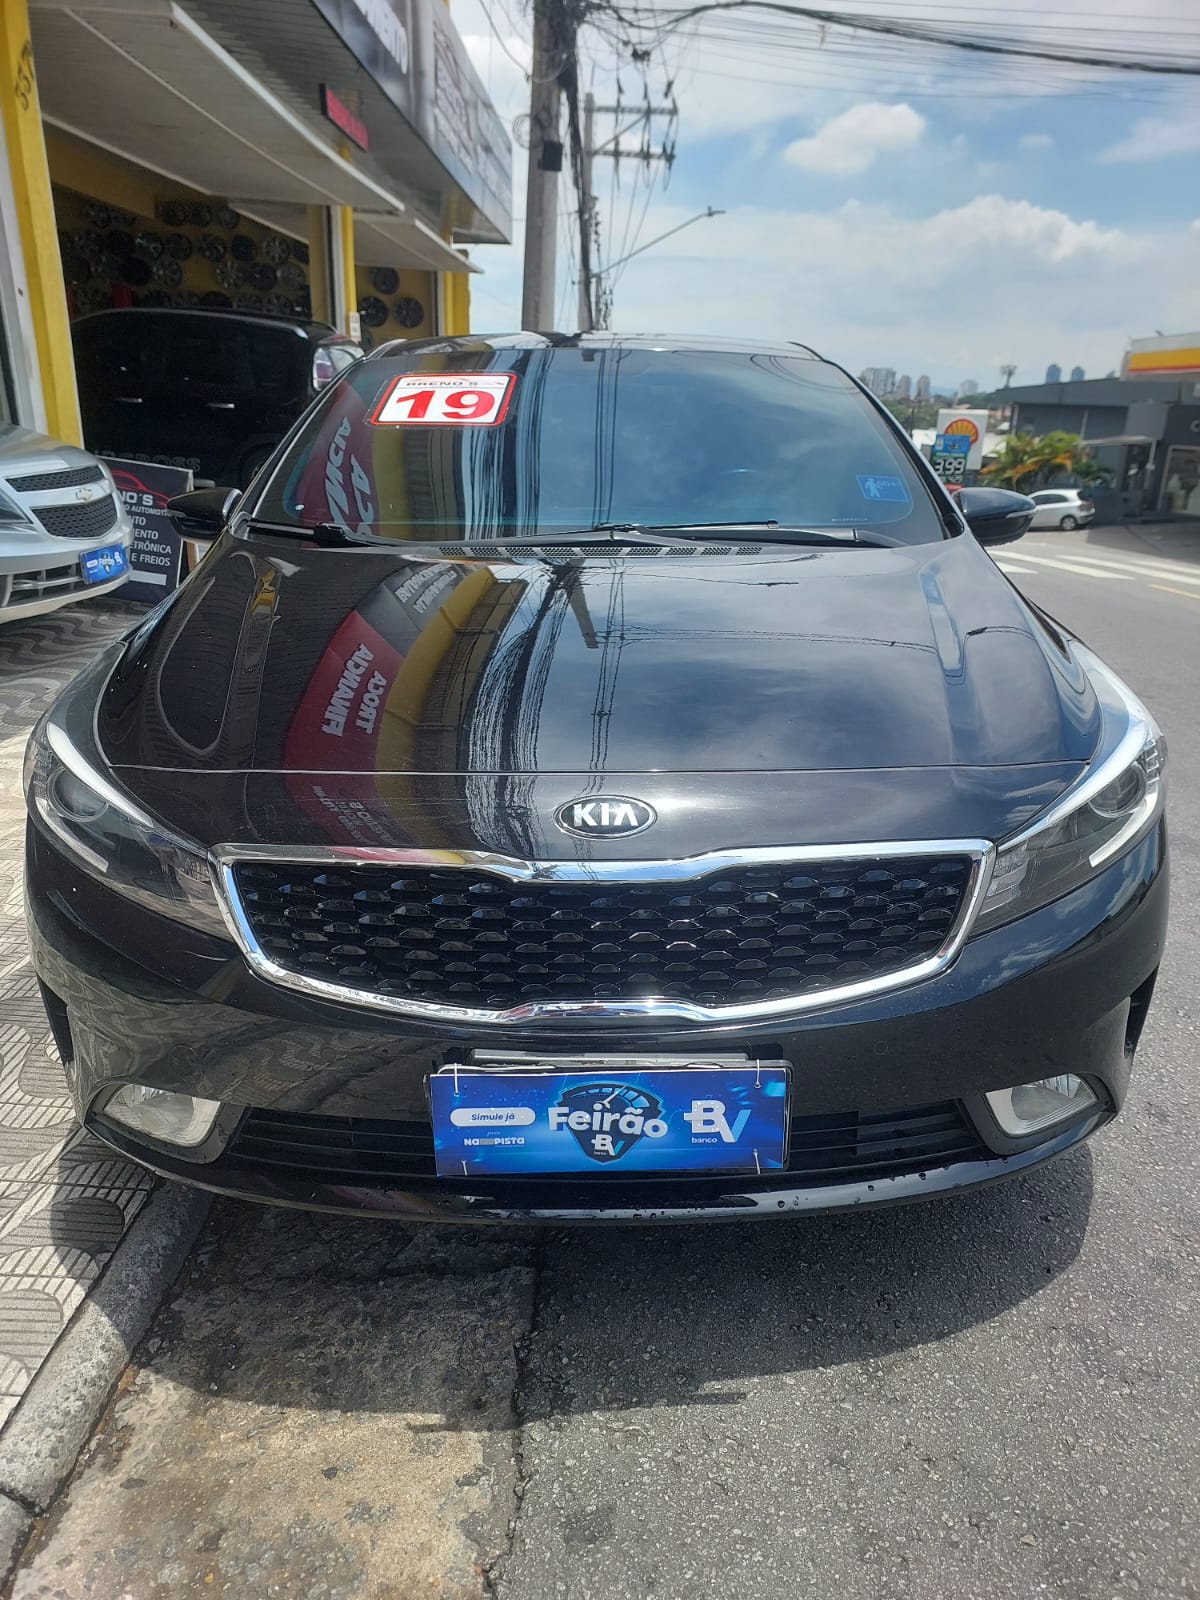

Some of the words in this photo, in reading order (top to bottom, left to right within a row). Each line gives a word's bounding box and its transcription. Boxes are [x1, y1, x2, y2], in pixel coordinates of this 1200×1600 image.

[396, 390, 495, 419] 19
[131, 552, 138, 562] E
[140, 553, 171, 566] FREIOS
[573, 802, 639, 827] KIA
[471, 1113, 504, 1121] Simule
[505, 1112, 515, 1122] já
[547, 1103, 668, 1138] Feirão
[683, 1100, 752, 1143] BV
[591, 1133, 624, 1156] BV
[691, 1136, 718, 1144] banco
